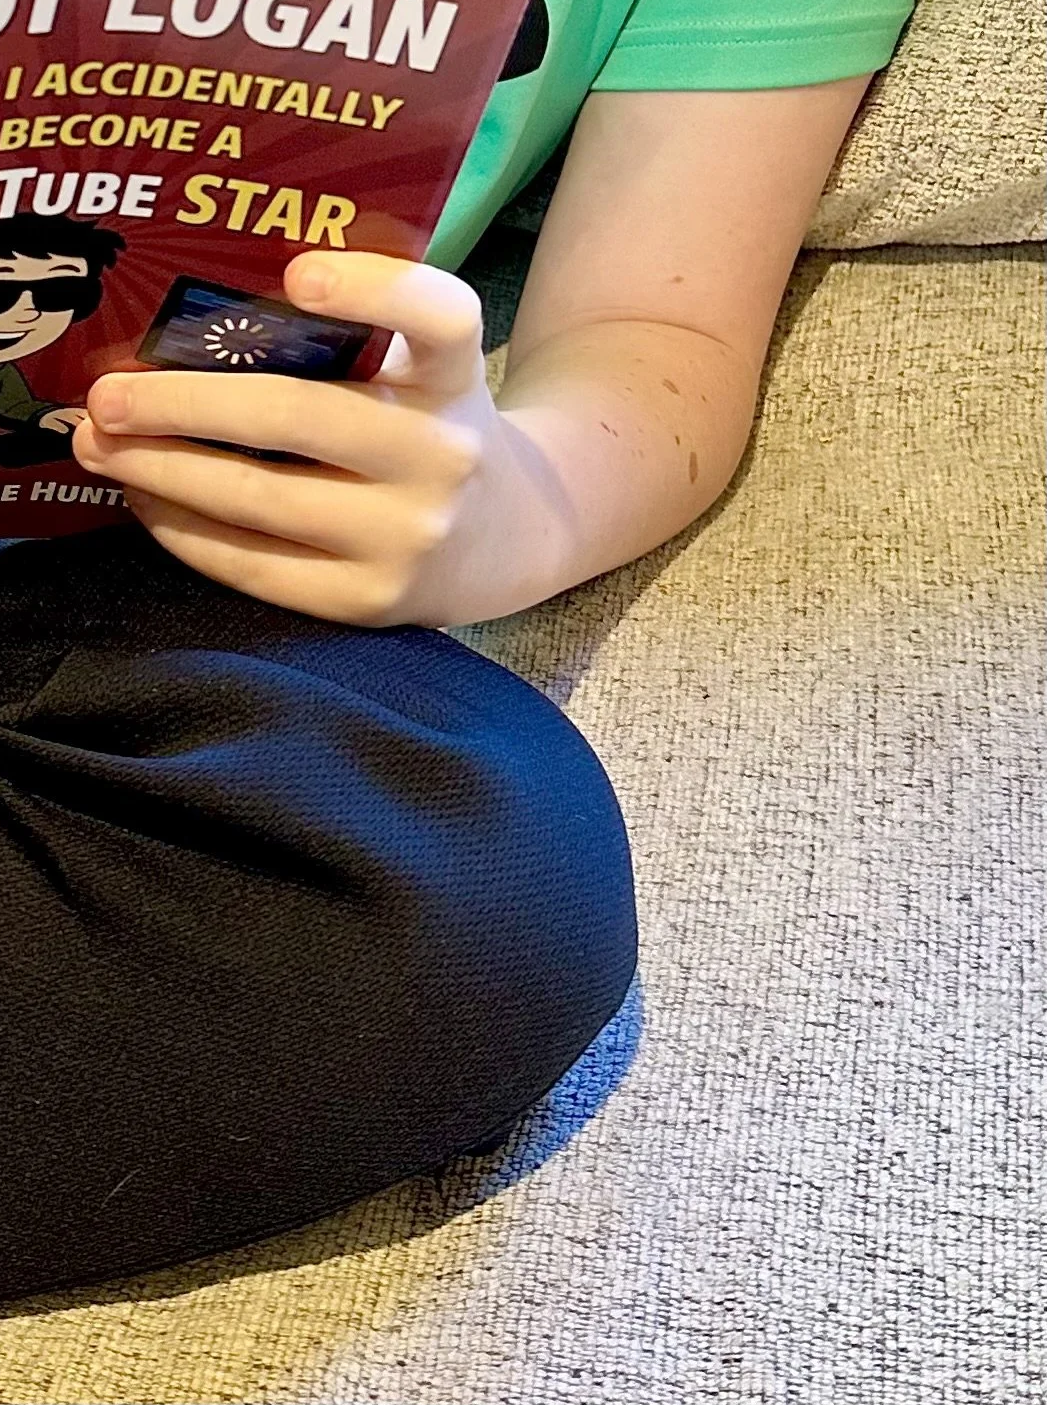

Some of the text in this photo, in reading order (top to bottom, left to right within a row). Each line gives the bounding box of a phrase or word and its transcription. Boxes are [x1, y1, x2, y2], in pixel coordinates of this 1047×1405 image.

[3, 66, 24, 102] I
[33, 61, 405, 132] ACCIDENTALLY
[208, 124, 243, 159] A
[175, 173, 358, 250] STAR
[30, 481, 129, 508] HUNT
